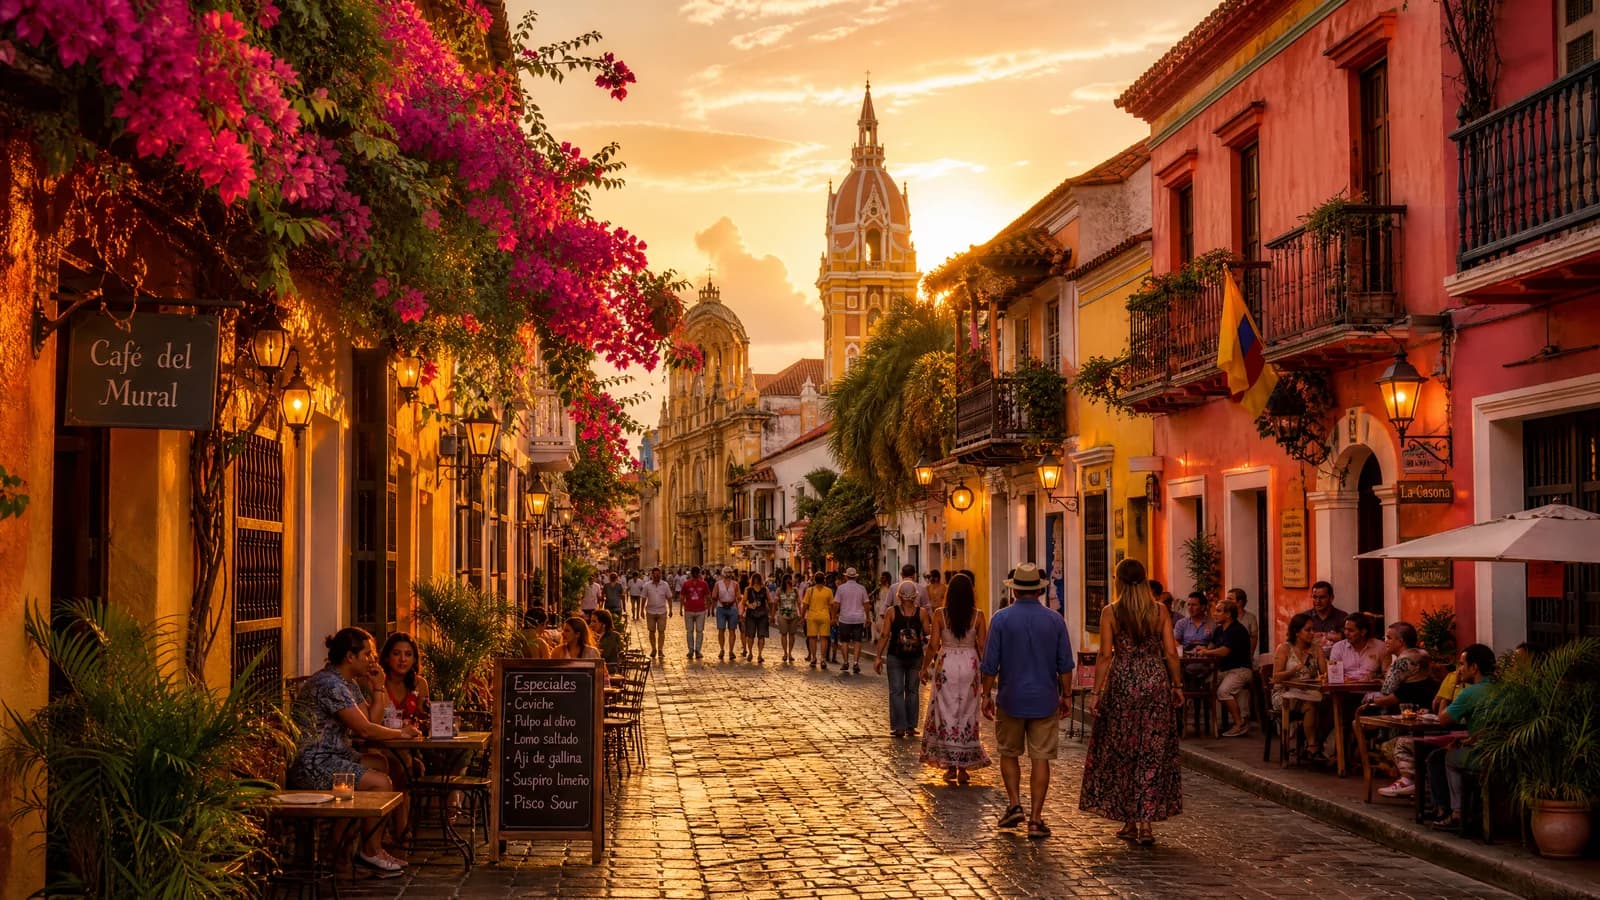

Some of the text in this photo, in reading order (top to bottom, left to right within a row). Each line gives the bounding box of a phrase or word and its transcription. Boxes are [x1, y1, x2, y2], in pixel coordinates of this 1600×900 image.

[90, 338, 192, 375] Café del
[98, 379, 178, 407] Mural
[1400, 485, 1451, 498] La Casona
[514, 675, 577, 696] Especiales
[514, 697, 554, 710] Ceviche
[515, 714, 576, 732] Pulpo al olivo
[514, 731, 579, 745] Lomo saltado
[533, 750, 545, 763] de
[548, 750, 582, 769] gallina
[513, 772, 590, 791] Suspiro limeño
[514, 794, 579, 810] Pisco Sour
